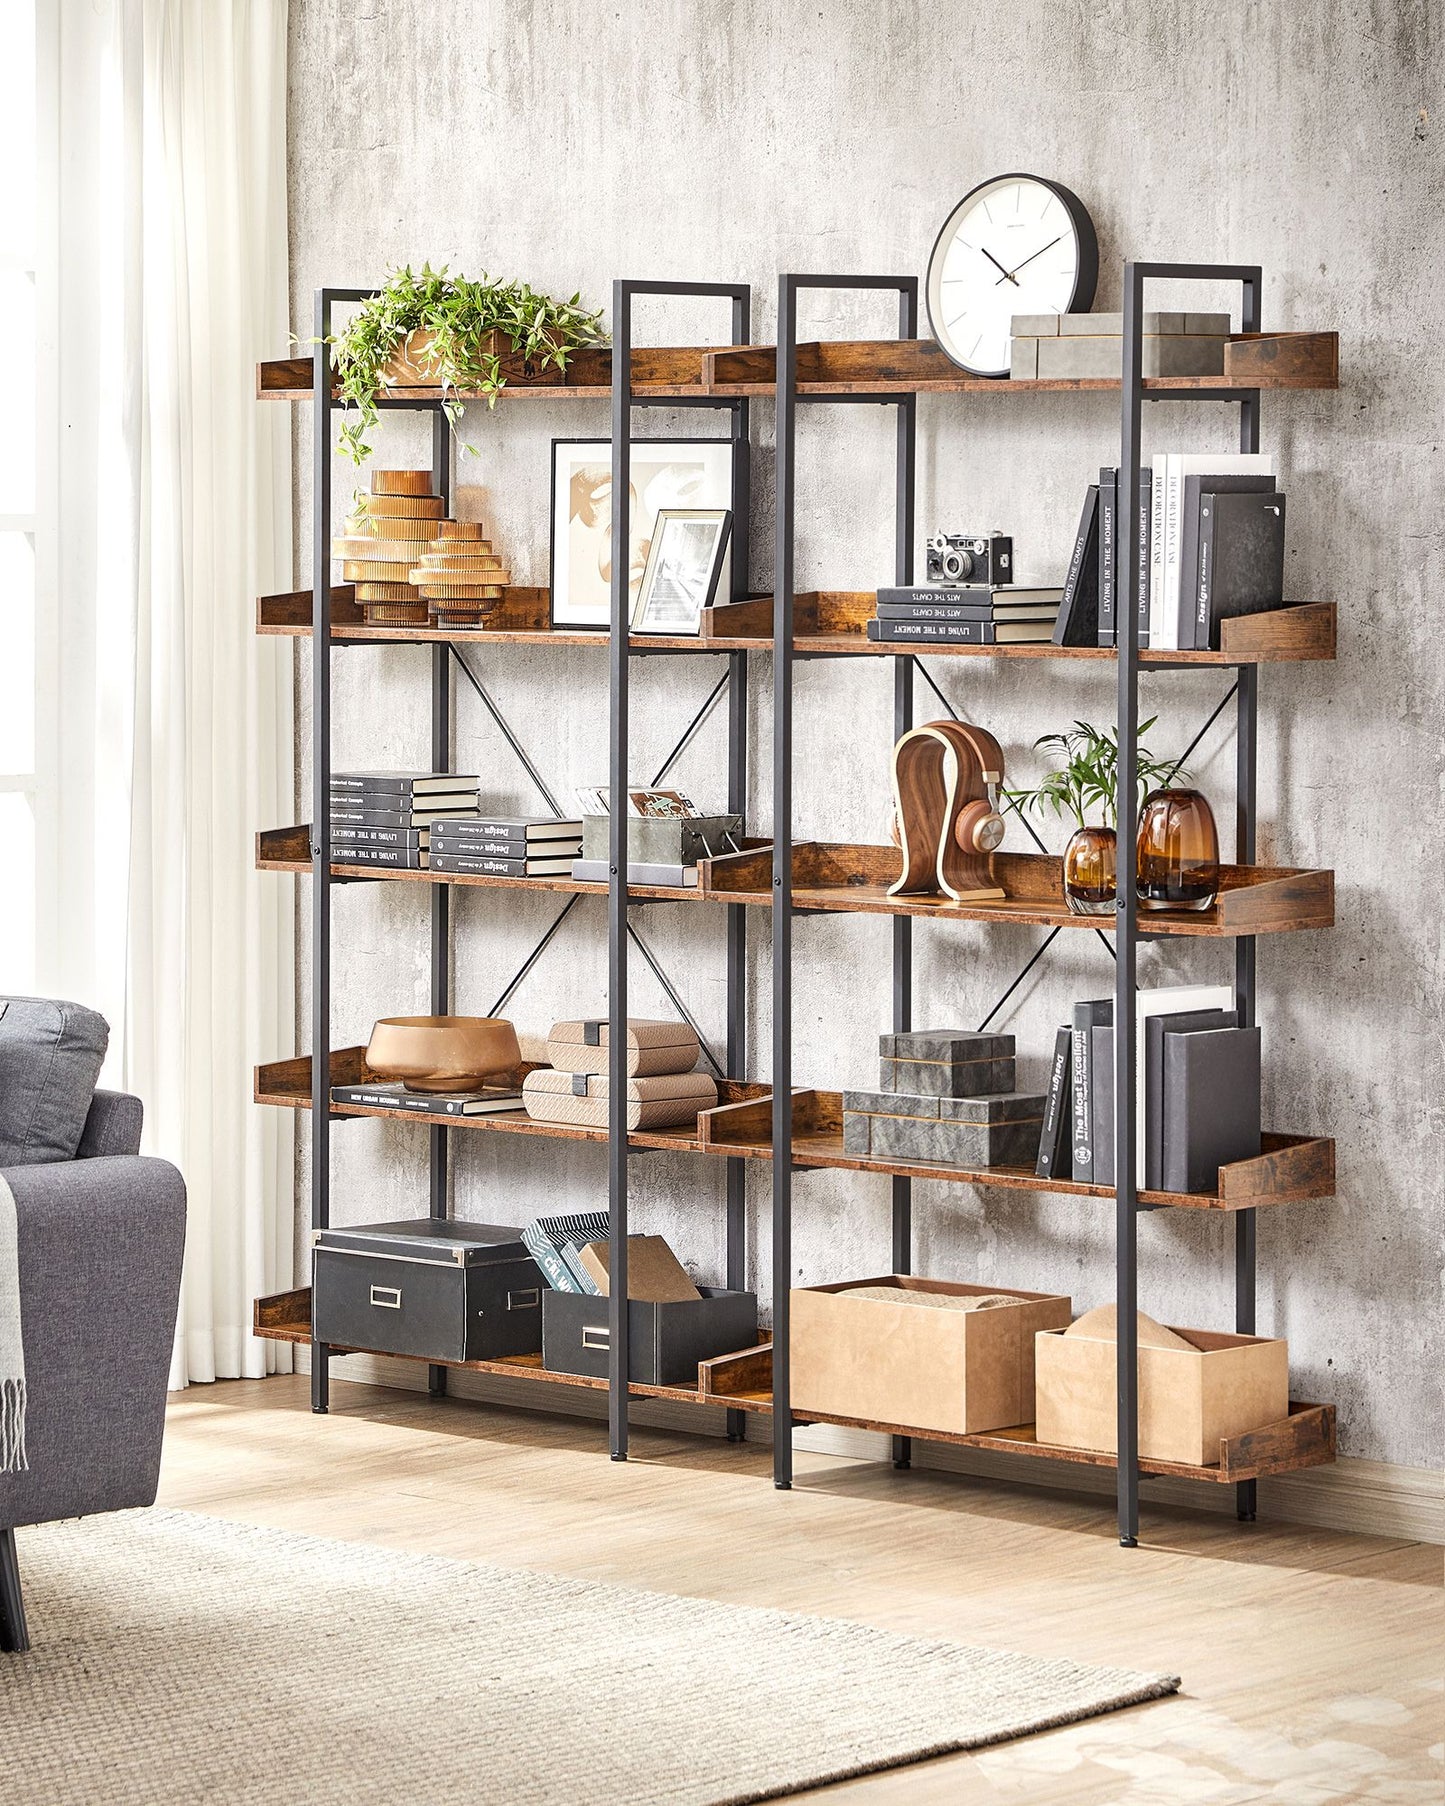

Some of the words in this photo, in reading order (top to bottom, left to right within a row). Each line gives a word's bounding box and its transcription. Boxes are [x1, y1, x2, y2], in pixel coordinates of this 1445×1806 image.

[1073, 536, 1084, 564] CRAFTS
[1069, 566, 1078, 581] THE
[1104, 569, 1111, 579] IN
[1139, 570, 1146, 580] IN
[1064, 584, 1074, 603] ARTS
[1198, 584, 1208, 624] Design
[894, 625, 922, 634] MOMENT
[923, 626, 937, 634] THE
[948, 626, 970, 636] LIVING
[332, 829, 356, 838] MOMENT
[484, 826, 510, 836] Design
[378, 832, 397, 841] LIVING
[332, 849, 356, 857] MOMENT
[484, 843, 510, 854] Design
[378, 852, 398, 860] LIVING
[484, 862, 509, 872] Design
[1073, 1030, 1083, 1084] Excellent
[1052, 1054, 1064, 1092] Design
[1074, 1086, 1084, 1116] Most
[1075, 1118, 1084, 1141] The
